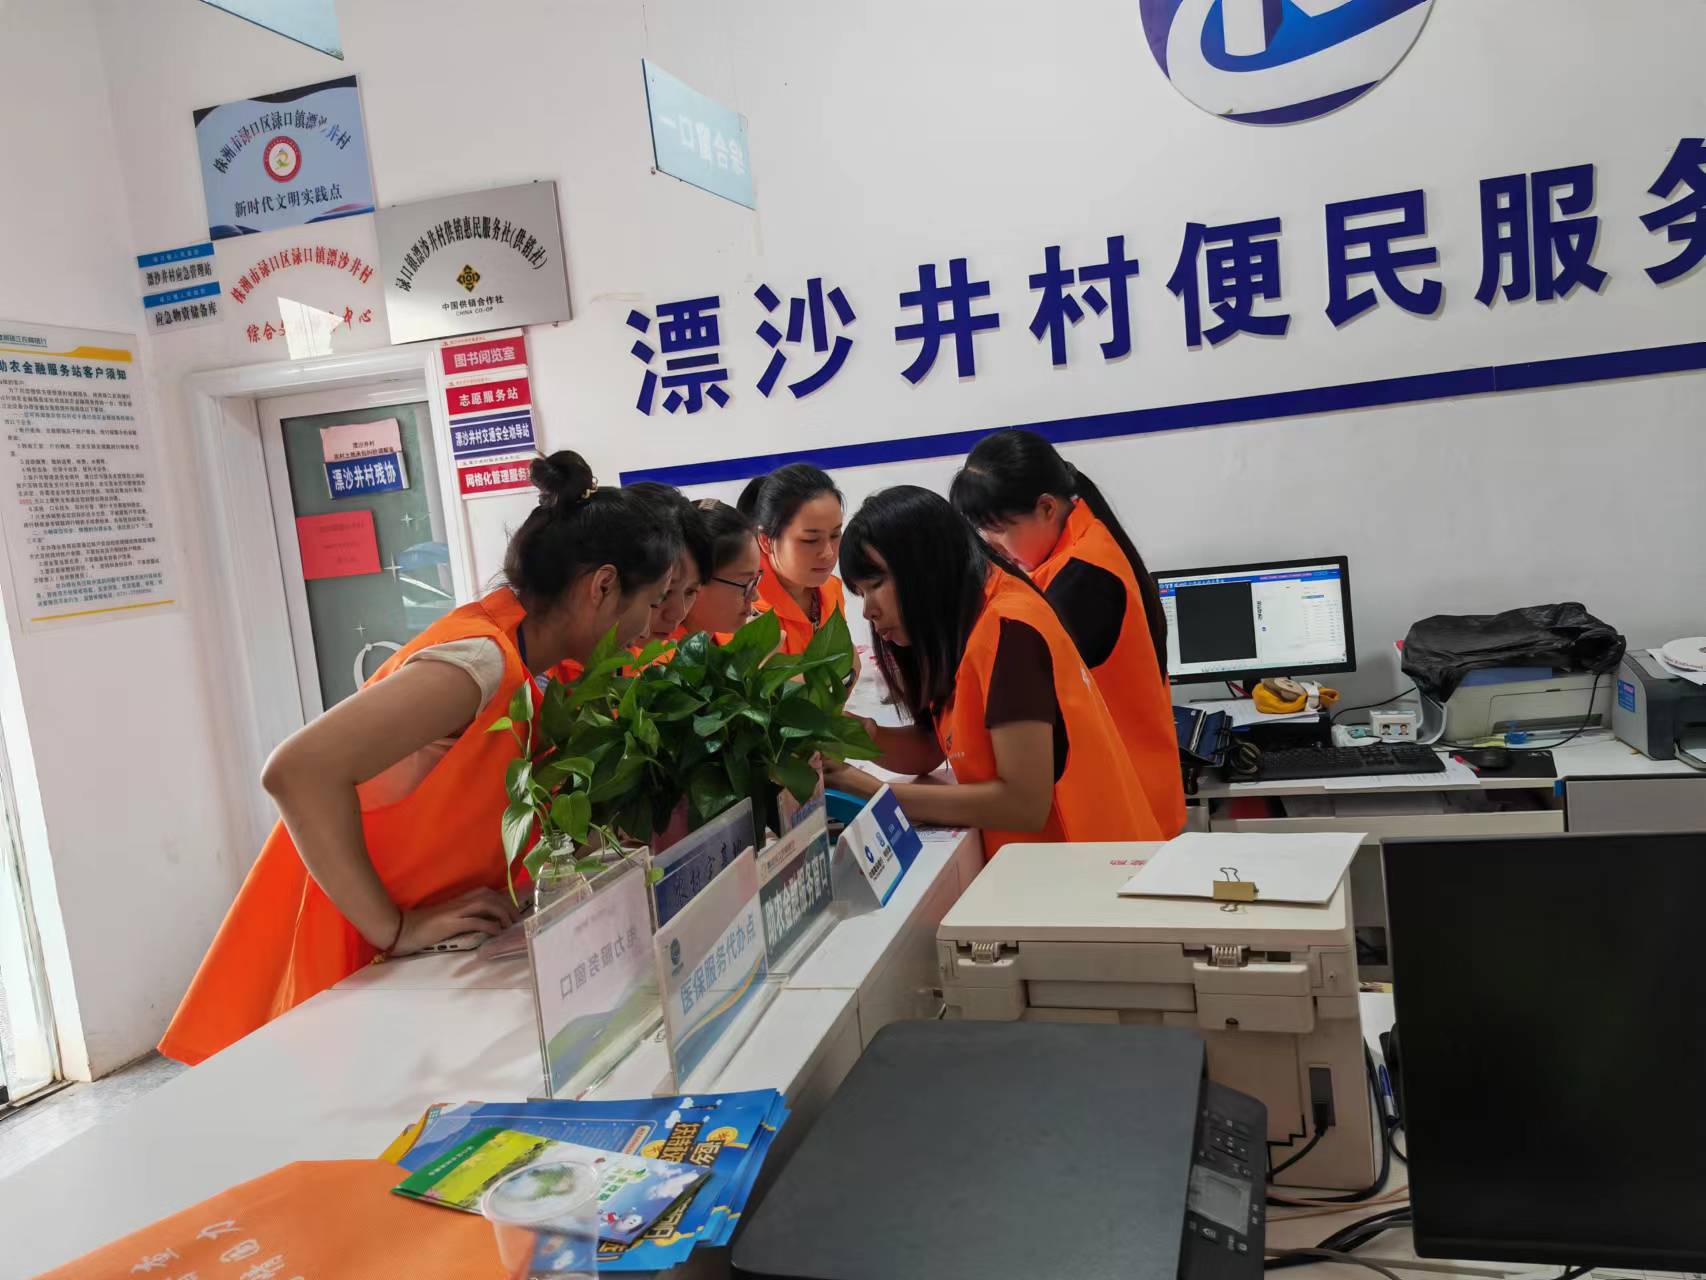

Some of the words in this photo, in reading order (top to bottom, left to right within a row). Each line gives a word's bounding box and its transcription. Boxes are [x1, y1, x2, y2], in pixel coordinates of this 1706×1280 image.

[233, 182, 343, 218] 新时代文明实践点
[230, 244, 375, 305] 株洲市渌口区渌口镇漂沙井村
[442, 295, 505, 312] 中国供销合作社
[453, 345, 516, 369] 图书阅览室
[458, 386, 519, 407] 志愿服务站
[454, 423, 531, 448] 漂沙井村交通安全劝导站
[331, 460, 397, 492] 漂沙井村残协
[465, 467, 531, 489] 网格化管理服务
[679, 913, 756, 1017] 医保服务代办点
